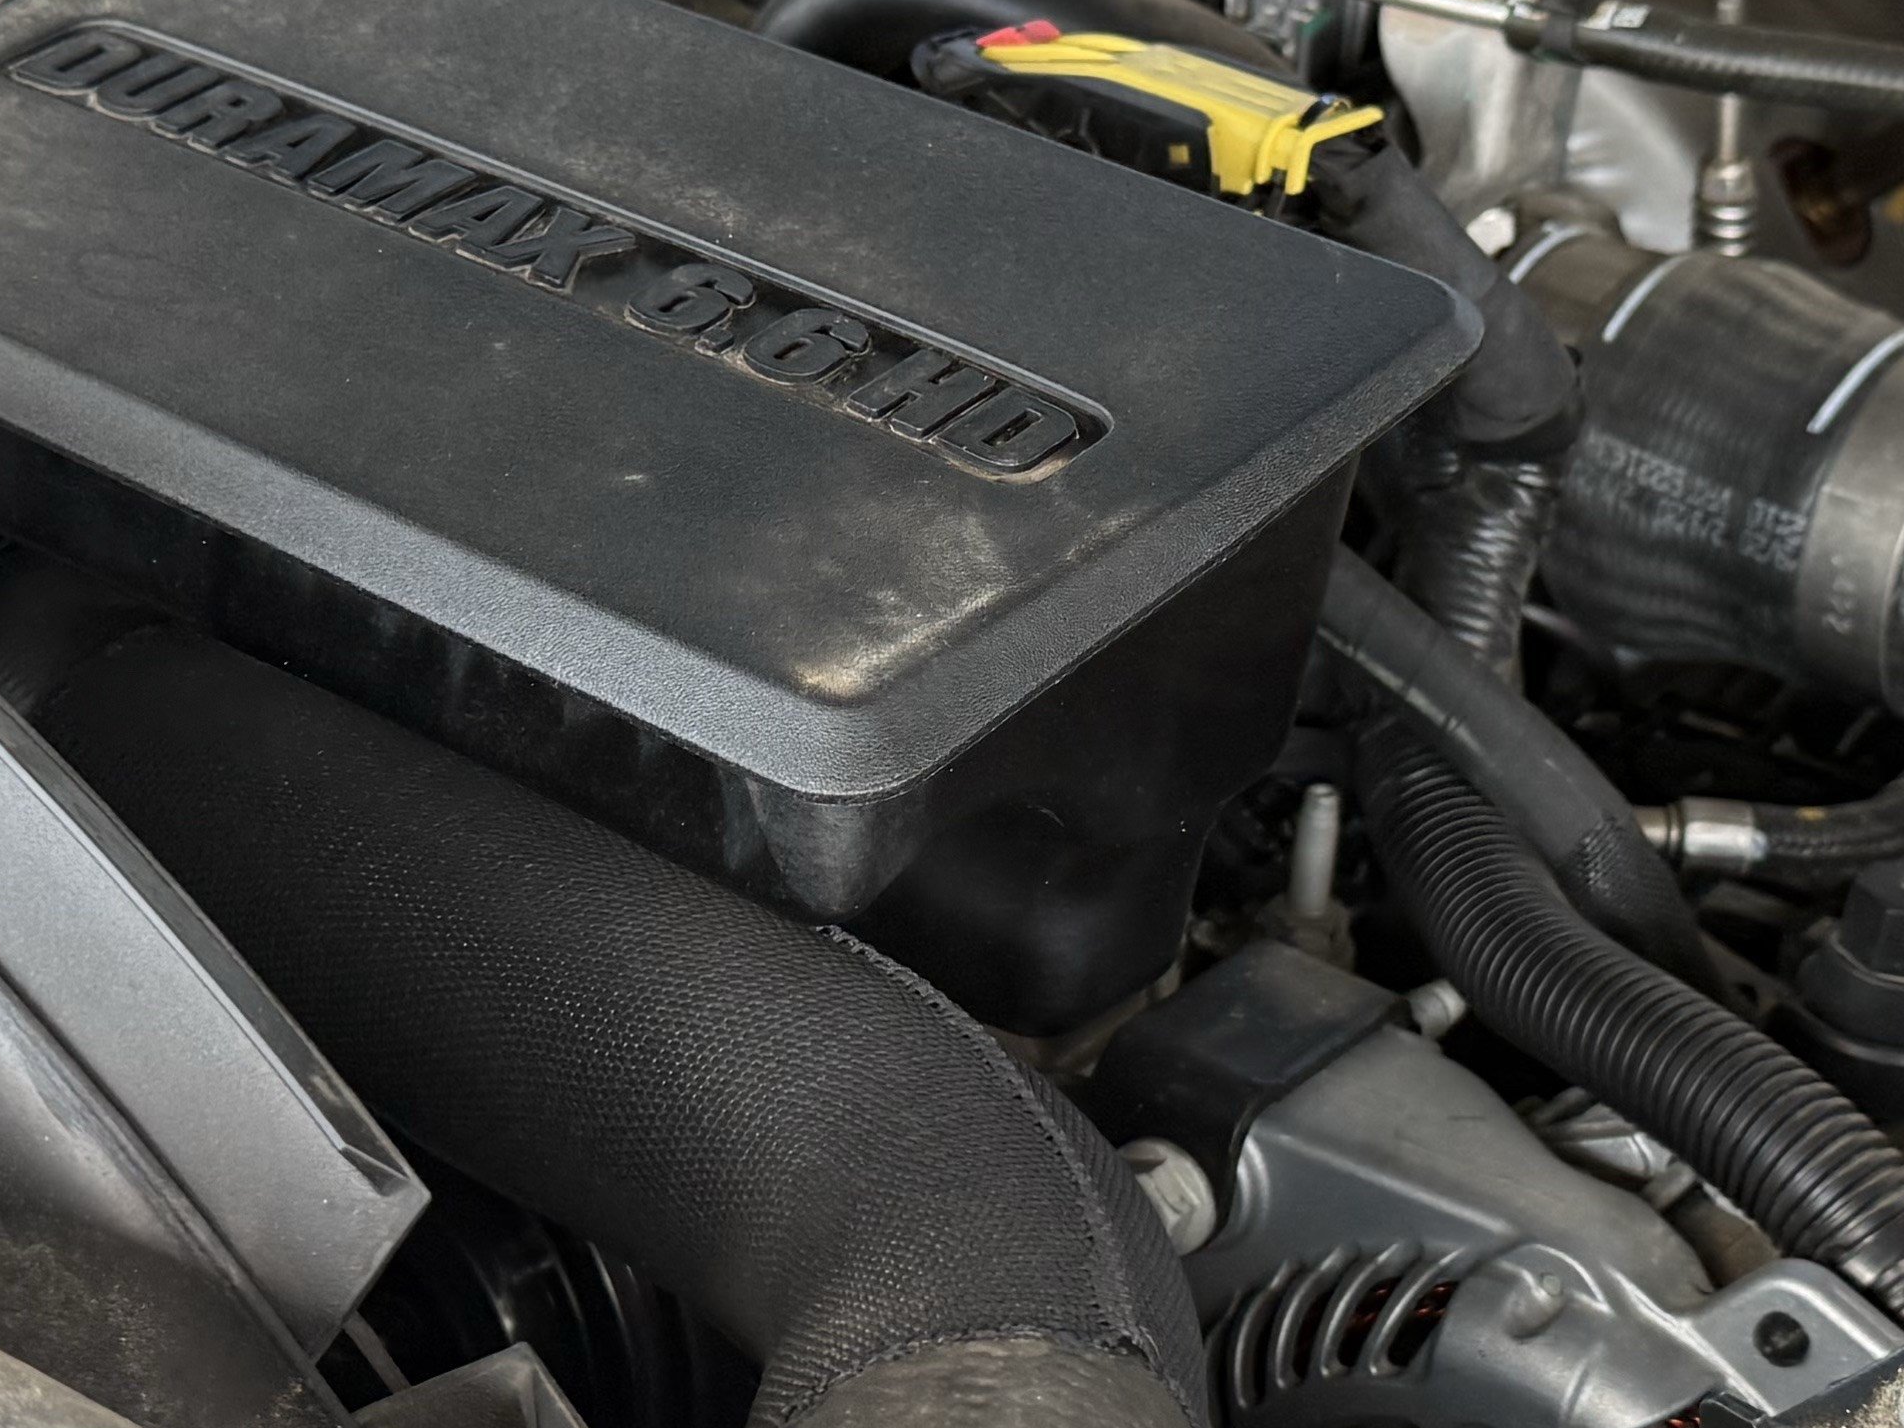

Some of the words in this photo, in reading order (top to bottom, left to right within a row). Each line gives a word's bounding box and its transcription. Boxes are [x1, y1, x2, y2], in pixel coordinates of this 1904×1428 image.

[7, 31, 637, 293] DURAMAX
[625, 262, 873, 386] 6.6
[844, 348, 1081, 474] HD
